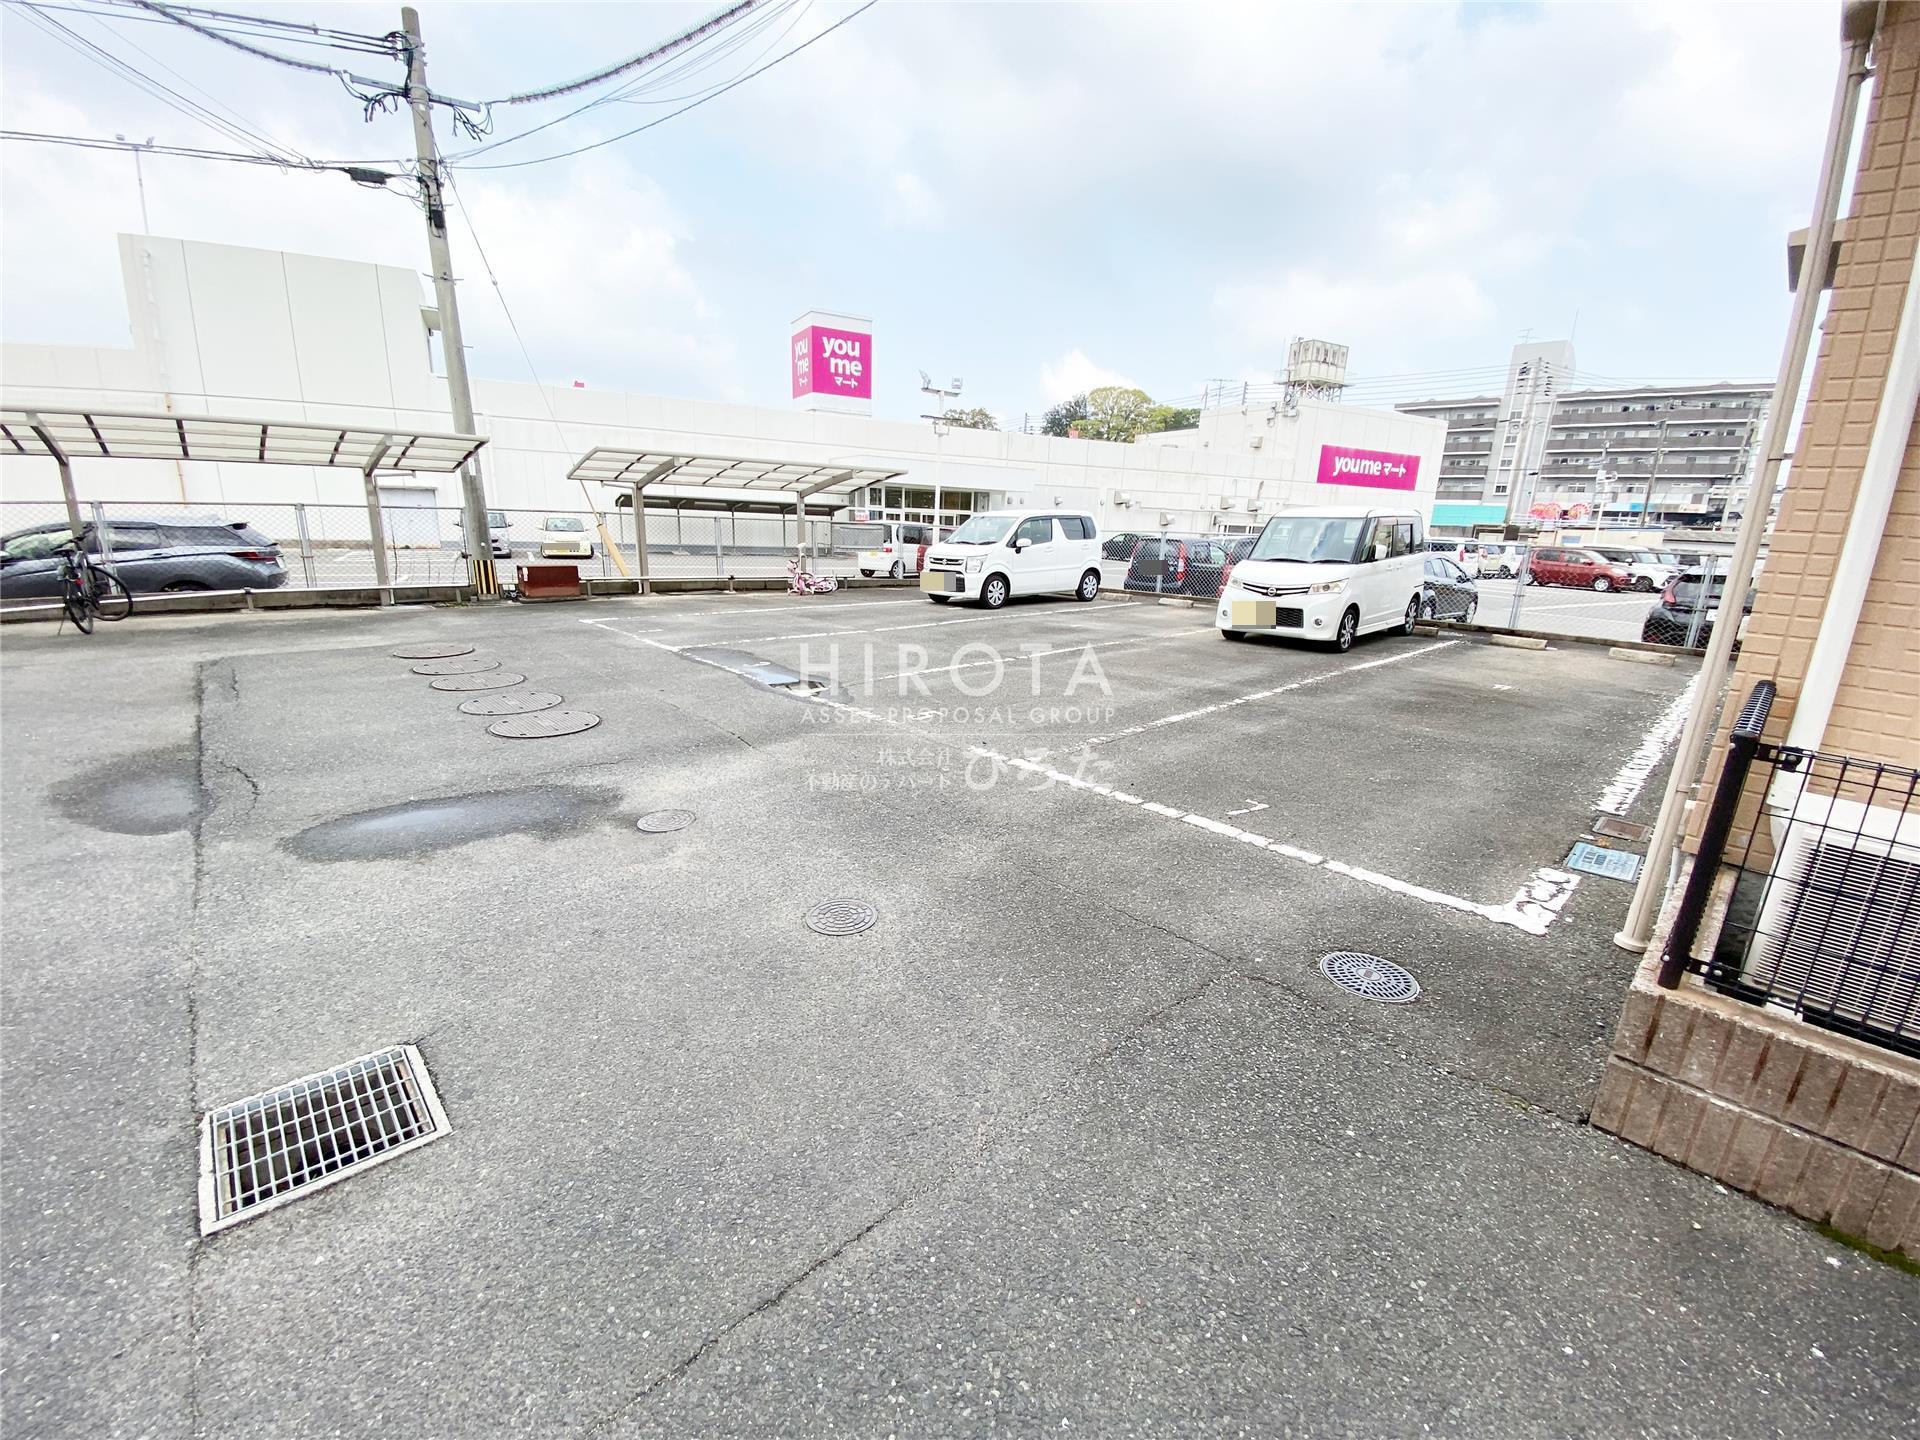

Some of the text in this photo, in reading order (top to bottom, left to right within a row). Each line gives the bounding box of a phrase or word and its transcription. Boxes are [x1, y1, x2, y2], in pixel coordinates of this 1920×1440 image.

[795, 338, 808, 363] you
[822, 336, 860, 357] you
[798, 358, 809, 376] me
[830, 357, 862, 376] me
[834, 376, 858, 389] マート
[1333, 456, 1406, 478] youme マート
